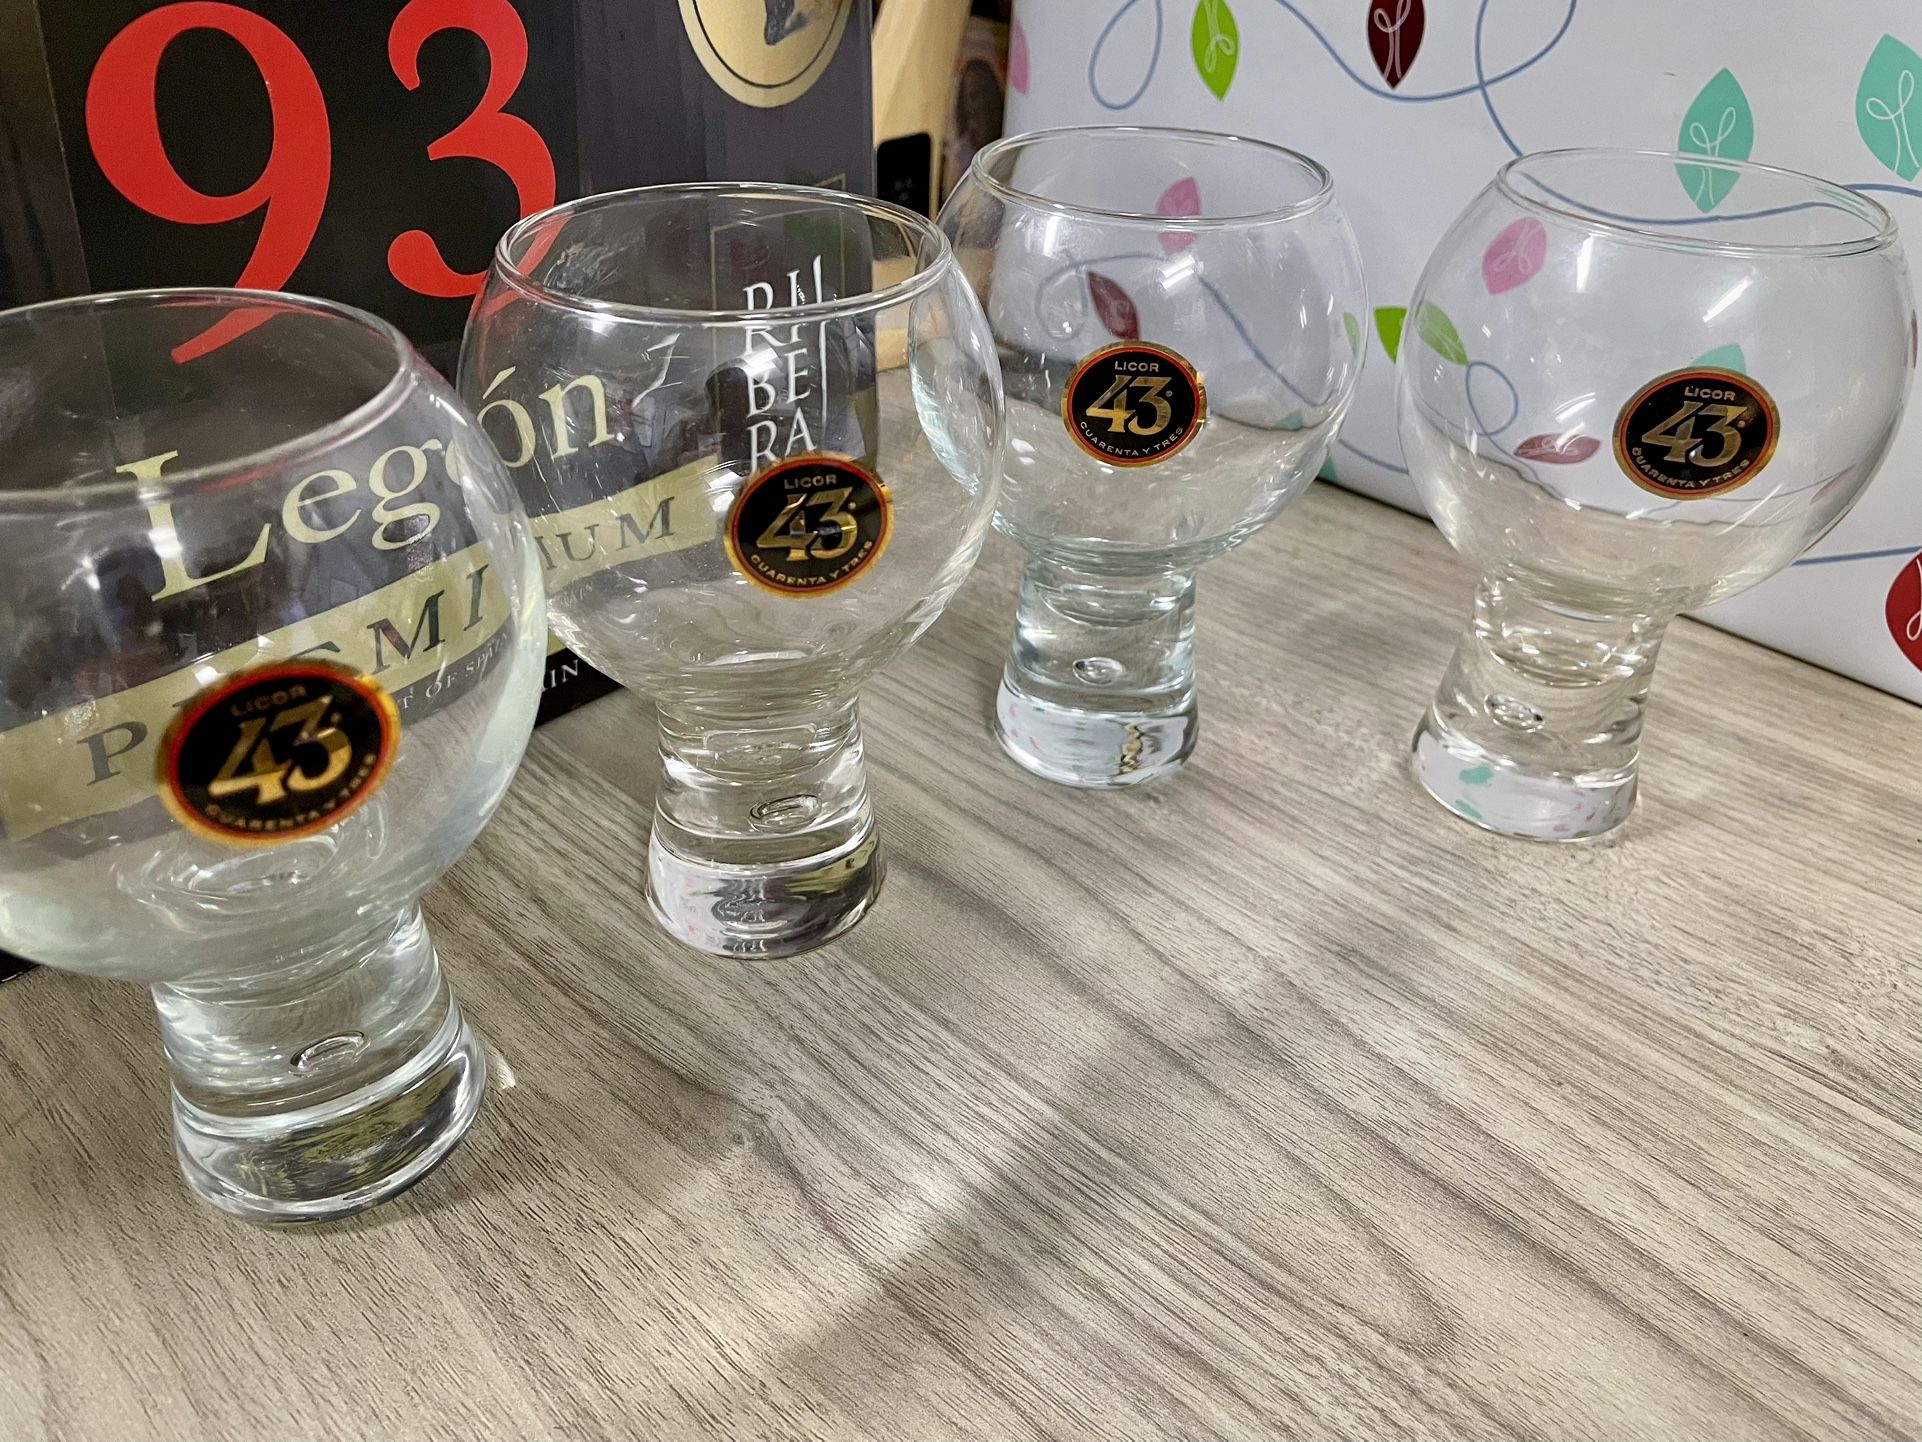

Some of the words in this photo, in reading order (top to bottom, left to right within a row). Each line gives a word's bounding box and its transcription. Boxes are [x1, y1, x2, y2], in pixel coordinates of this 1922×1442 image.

[85, 0, 557, 364] 93
[1114, 360, 1160, 373] LICOR
[1684, 385, 1737, 401] LICOR
[1085, 374, 1173, 436] 43
[1080, 421, 1139, 457] CUARENTA
[1142, 447, 1151, 455] Y
[1154, 426, 1184, 451] TRES
[1641, 400, 1748, 468] 43
[115, 365, 616, 602] Legón
[783, 473, 838, 490] LICOR
[1631, 446, 1696, 489] CUARENTA
[1699, 480, 1710, 488] Y
[1712, 458, 1750, 484] TRES
[755, 486, 859, 562] 43
[750, 553, 828, 586] CUARENTA
[829, 569, 840, 580] Y
[843, 540, 874, 573] TRES
[77, 496, 675, 787] PMIUM
[231, 684, 307, 717] LICOR
[207, 695, 353, 805] 43
